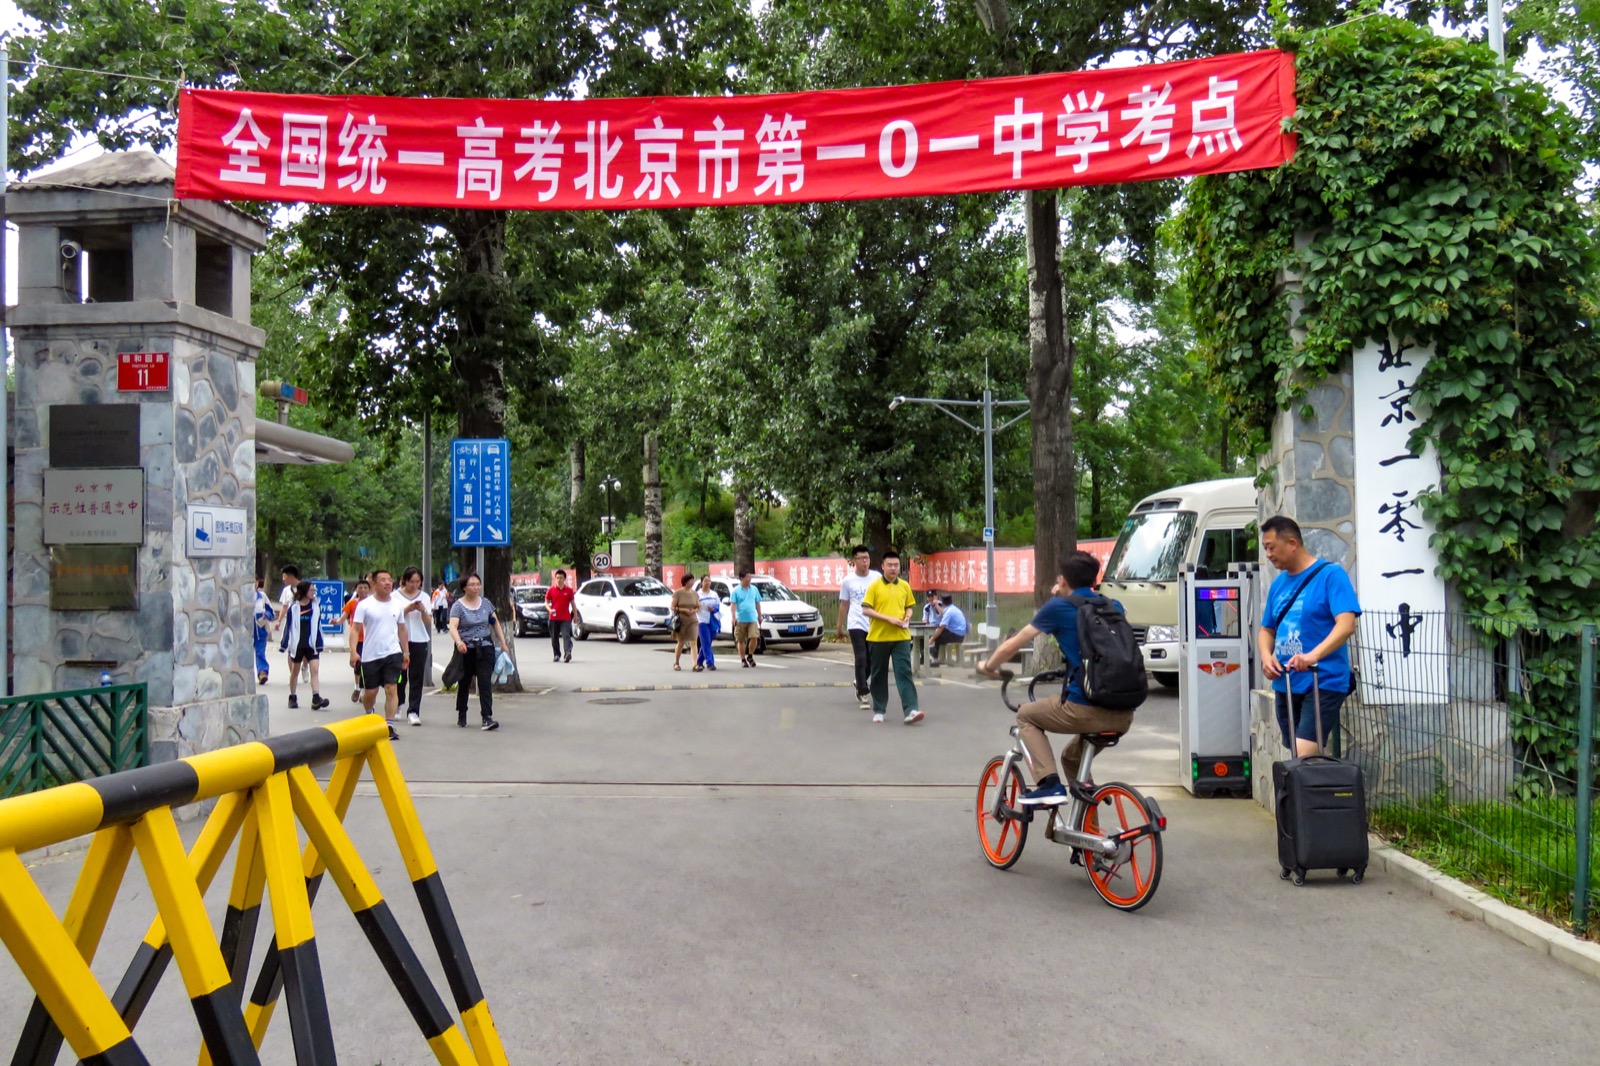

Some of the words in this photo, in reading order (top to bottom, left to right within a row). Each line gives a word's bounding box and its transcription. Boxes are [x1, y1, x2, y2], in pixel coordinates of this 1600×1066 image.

[137, 369, 149, 386] 11
[74, 482, 114, 493] 北京市
[463, 482, 473, 516] 专用道
[49, 500, 138, 516] 示范性普通高中
[595, 556, 609, 567] 20
